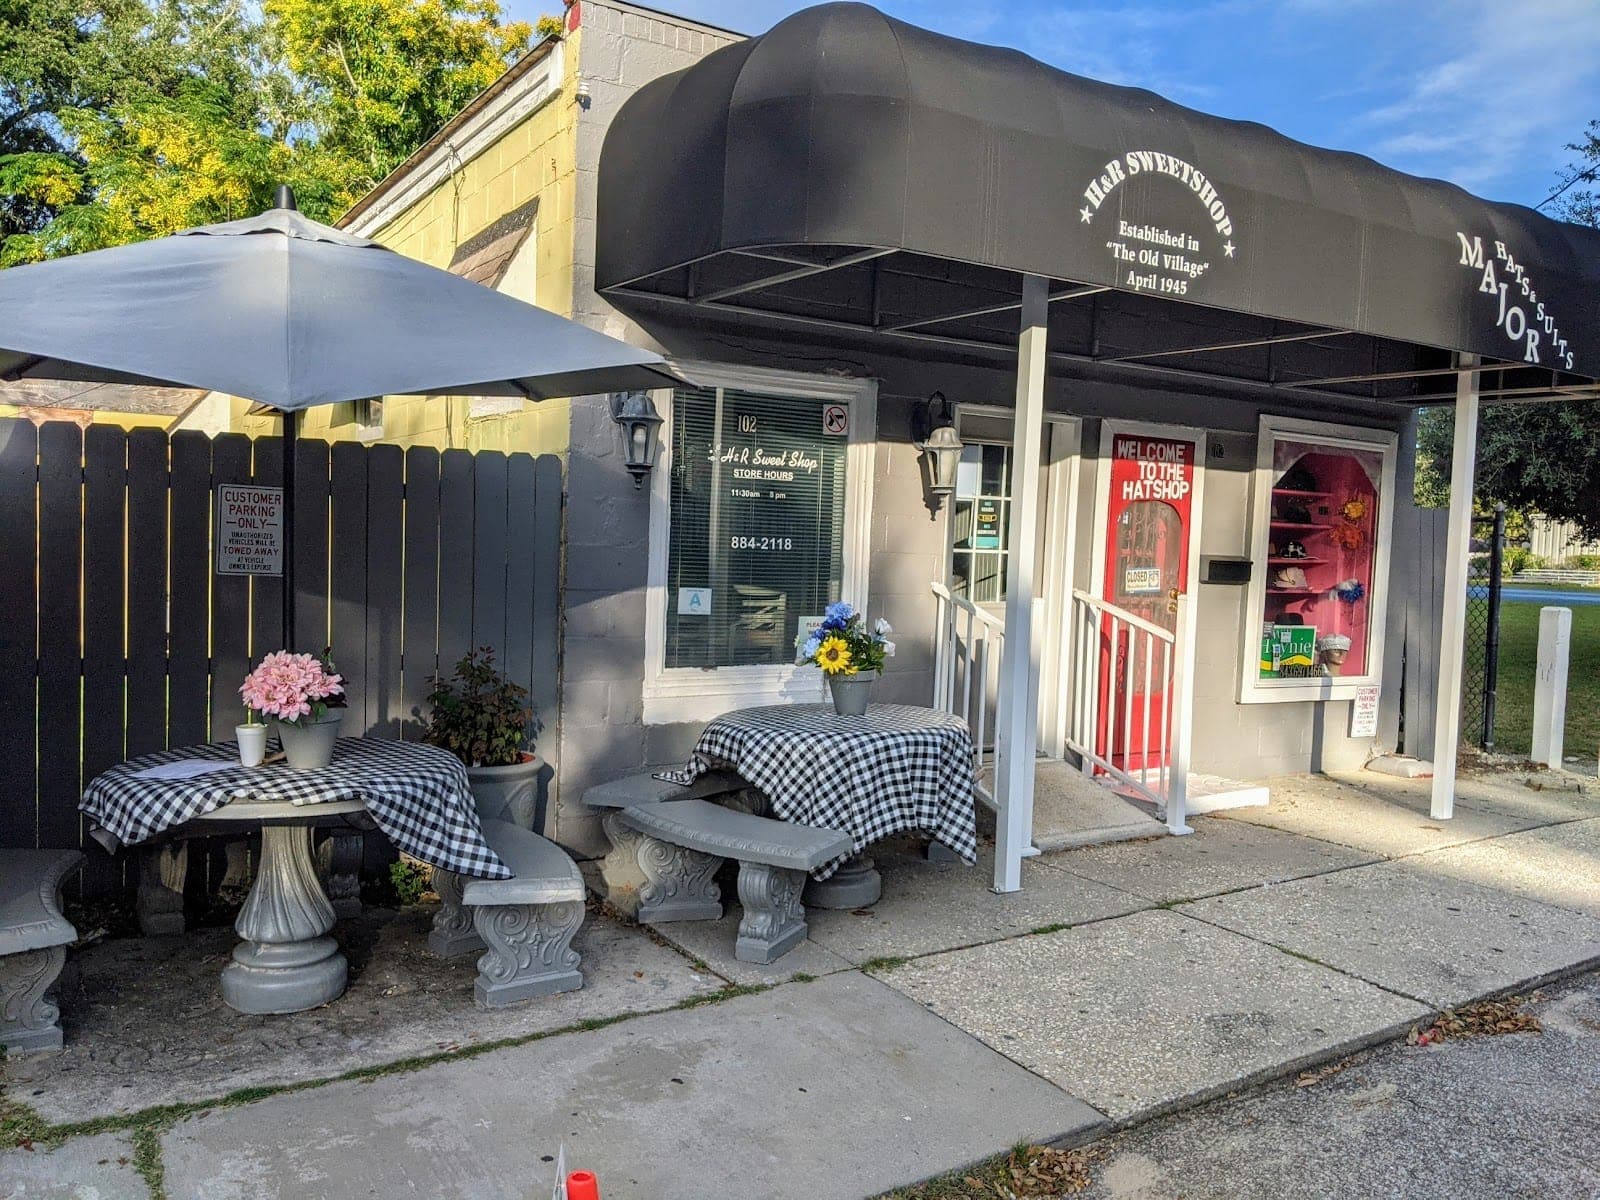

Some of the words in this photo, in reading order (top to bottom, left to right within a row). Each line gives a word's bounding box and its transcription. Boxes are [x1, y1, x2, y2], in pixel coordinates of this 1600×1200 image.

[1084, 160, 1126, 209] H&R
[1126, 151, 1233, 237] SWEETSHOP
[1119, 220, 1185, 249] Established
[1187, 235, 1200, 251] in
[1139, 249, 1159, 267] Old
[1126, 270, 1157, 291] April
[1159, 277, 1188, 295] 1945
[1457, 231, 1540, 363] MAJOR
[1495, 240, 1530, 295] HATS
[1537, 302, 1574, 370] SUITS
[737, 414, 757, 433] 102
[720, 446, 749, 465] H&R
[752, 448, 786, 467] Sweet
[788, 450, 818, 474] Shop
[1117, 439, 1186, 463] WELCOME
[733, 468, 763, 479] STORE
[764, 470, 794, 481] HOURS
[1138, 461, 1157, 480] TO
[1159, 463, 1185, 481] THE
[224, 491, 281, 505] CUSTOMER
[775, 492, 786, 500] pm
[1122, 480, 1190, 500] HATSHOP
[229, 504, 275, 517] PARKING
[231, 531, 274, 540] UNAUTHORIZED
[731, 536, 792, 550] 884-2118
[223, 546, 252, 555] TOWED
[254, 547, 279, 556] AWAY
[1127, 571, 1148, 583] CLOSED
[689, 592, 702, 607] A
[1358, 687, 1378, 695] CUSTOMER
